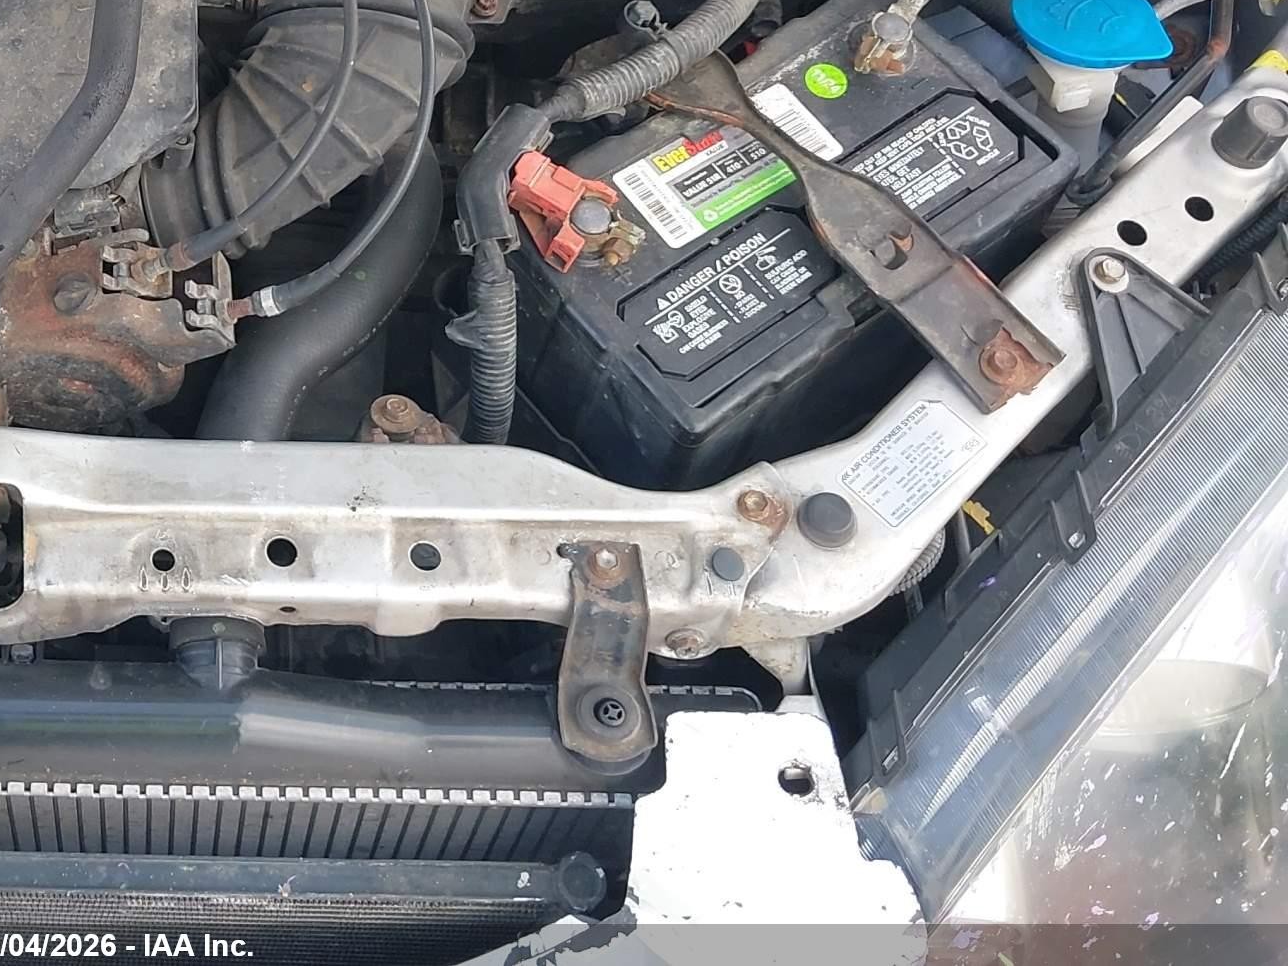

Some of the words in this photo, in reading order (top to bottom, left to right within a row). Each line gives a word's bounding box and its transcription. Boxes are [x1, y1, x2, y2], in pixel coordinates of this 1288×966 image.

[750, 148, 766, 160] 510
[891, 178, 907, 190] HELP
[905, 168, 922, 180] FAST
[665, 266, 717, 301] DANGER
[716, 260, 727, 272] /
[722, 233, 767, 266] POISON
[684, 295, 708, 311] SHIELD
[689, 305, 707, 318] EYES
[682, 308, 717, 333] EXPLOSIVE
[851, 458, 863, 472] AIR
[862, 425, 903, 464] CONDITIONER
[900, 403, 927, 428] SYSTEM
